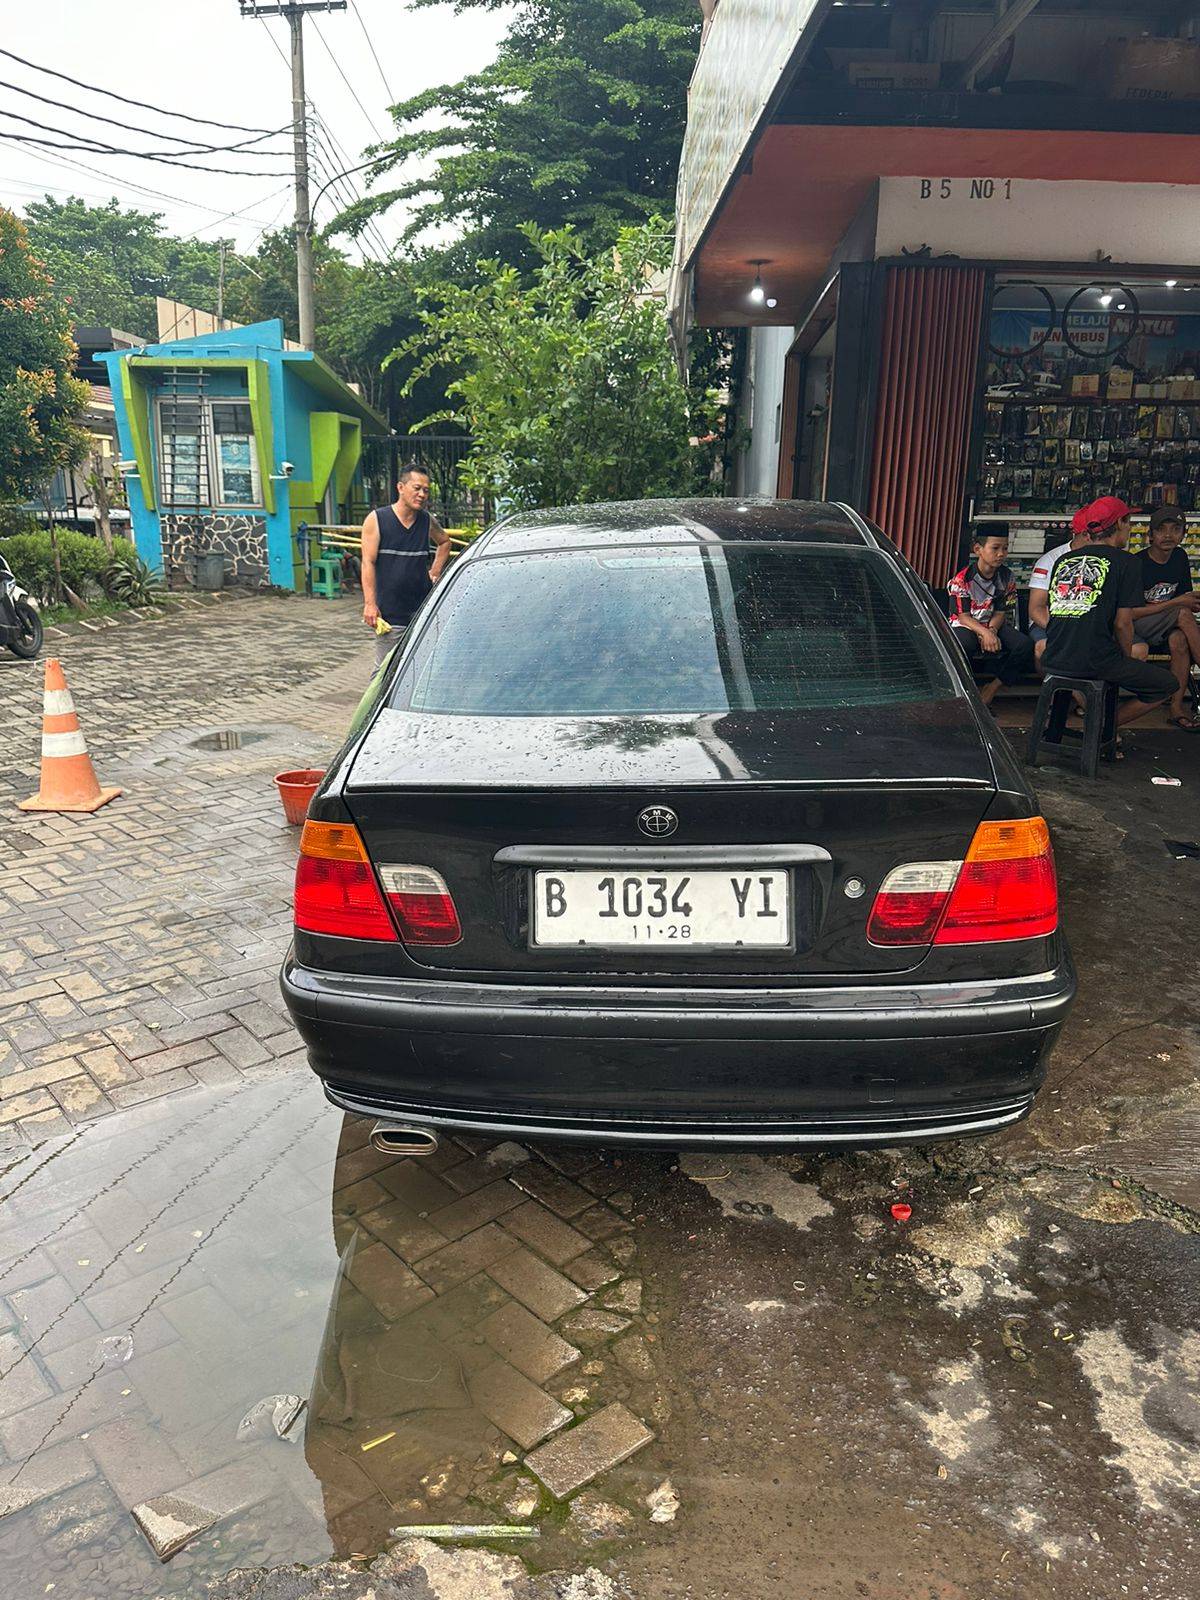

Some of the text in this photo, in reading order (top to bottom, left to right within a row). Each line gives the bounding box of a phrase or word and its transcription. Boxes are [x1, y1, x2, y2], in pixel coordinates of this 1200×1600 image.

[920, 178, 1012, 200] B 5 NO 1
[641, 809, 674, 820] BMW
[545, 877, 778, 918] B 1034 YI
